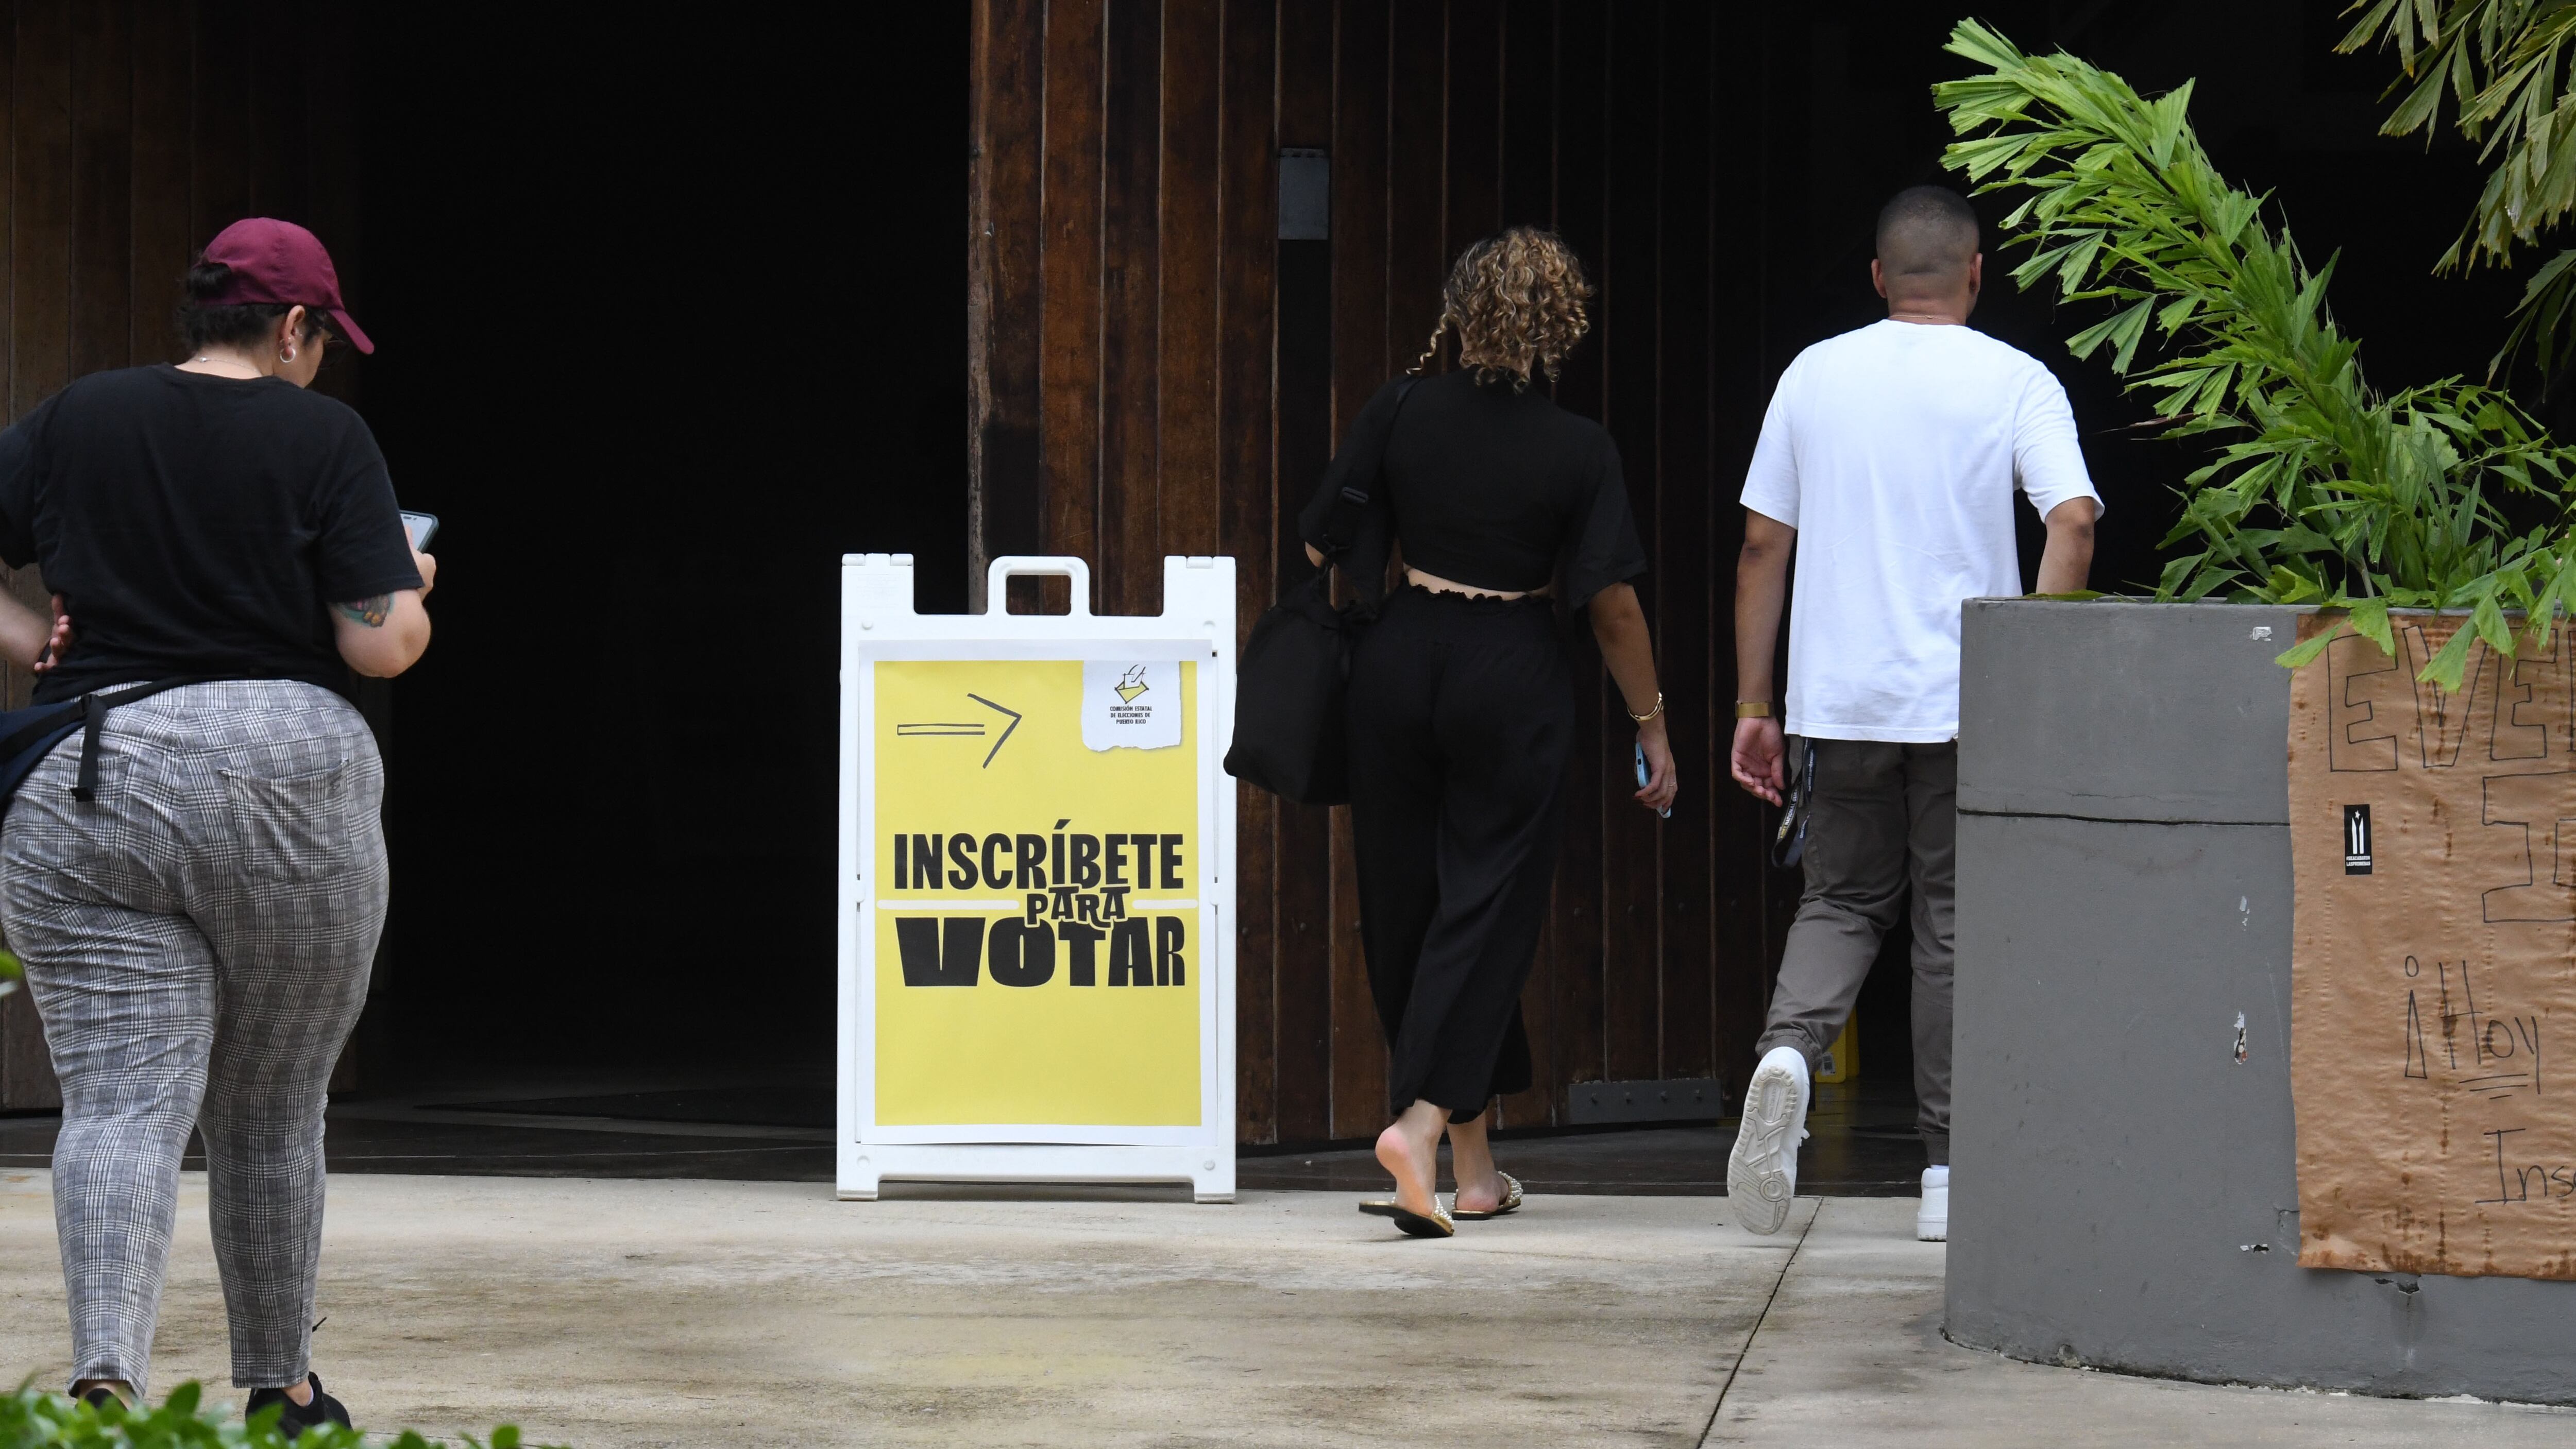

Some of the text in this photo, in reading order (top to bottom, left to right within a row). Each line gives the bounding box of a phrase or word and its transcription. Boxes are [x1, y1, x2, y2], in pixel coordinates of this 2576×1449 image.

[2327, 624, 2576, 772] EVE
[894, 819, 1183, 890] INSCRÍBETE
[1026, 885, 1131, 928] PARA
[895, 916, 1185, 987] VOTAR
[2475, 1128, 2576, 1205] Ins
